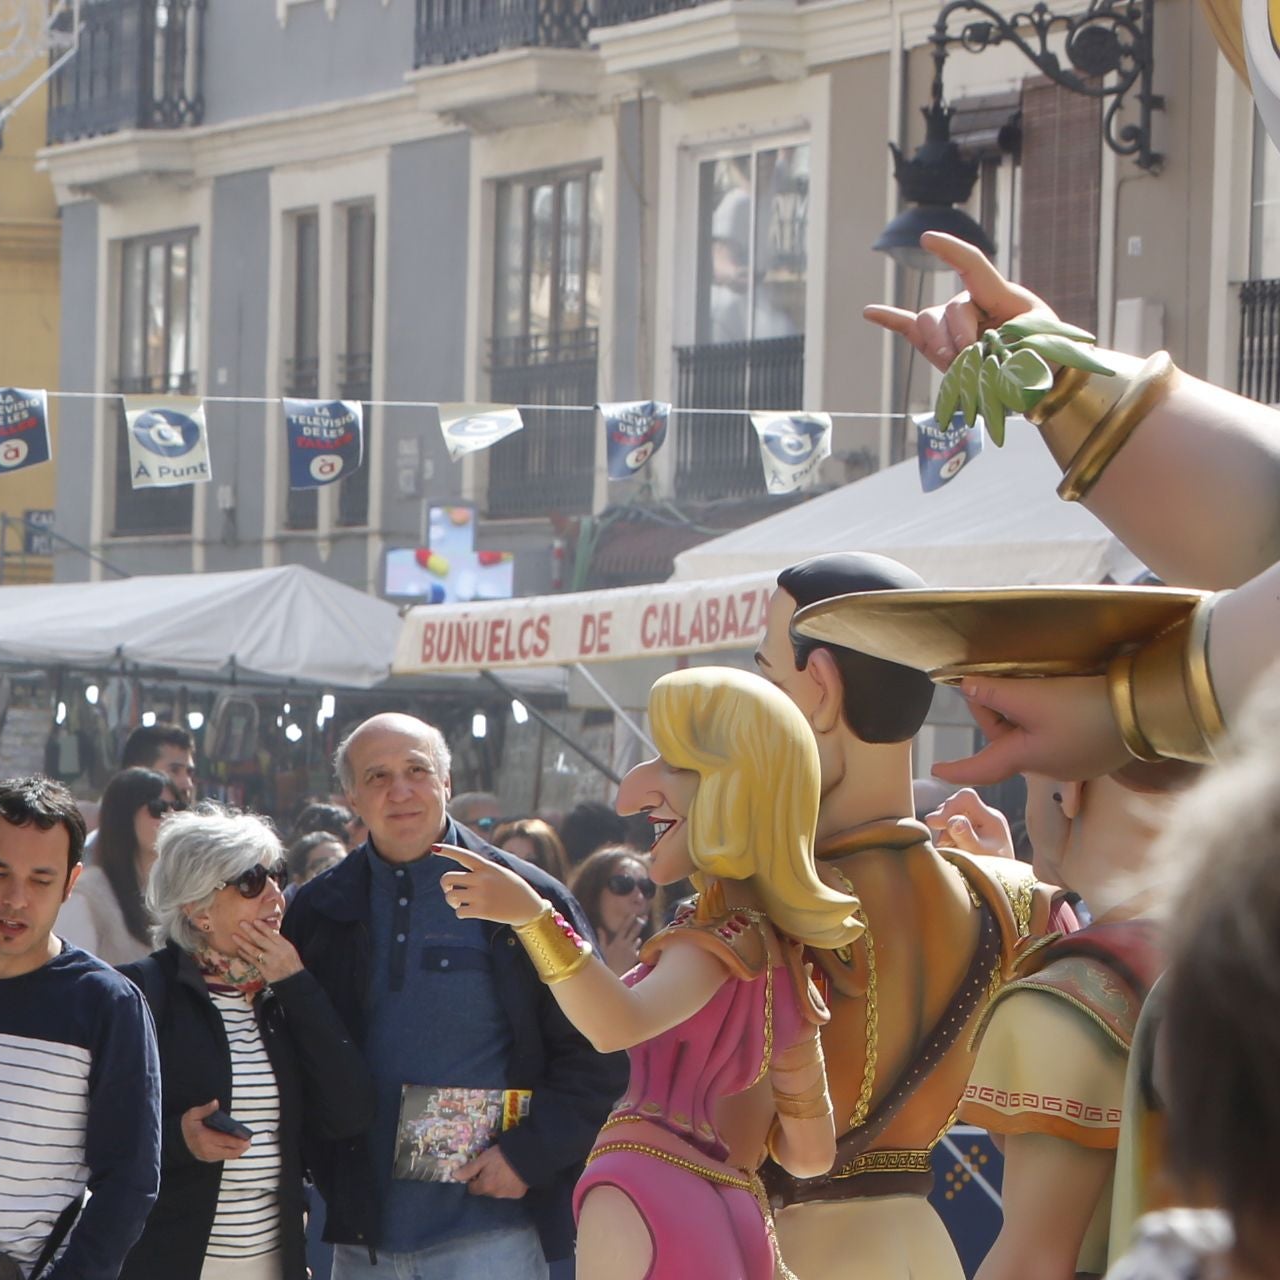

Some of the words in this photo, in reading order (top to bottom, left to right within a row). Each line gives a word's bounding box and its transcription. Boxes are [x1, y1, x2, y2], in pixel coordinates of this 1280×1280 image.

[0, 393, 14, 405] LA
[7, 409, 30, 424] LES
[314, 406, 331, 417] LA
[303, 426, 320, 437] DE
[323, 427, 345, 439] LES
[158, 462, 208, 478] Punt
[579, 611, 613, 656] DE
